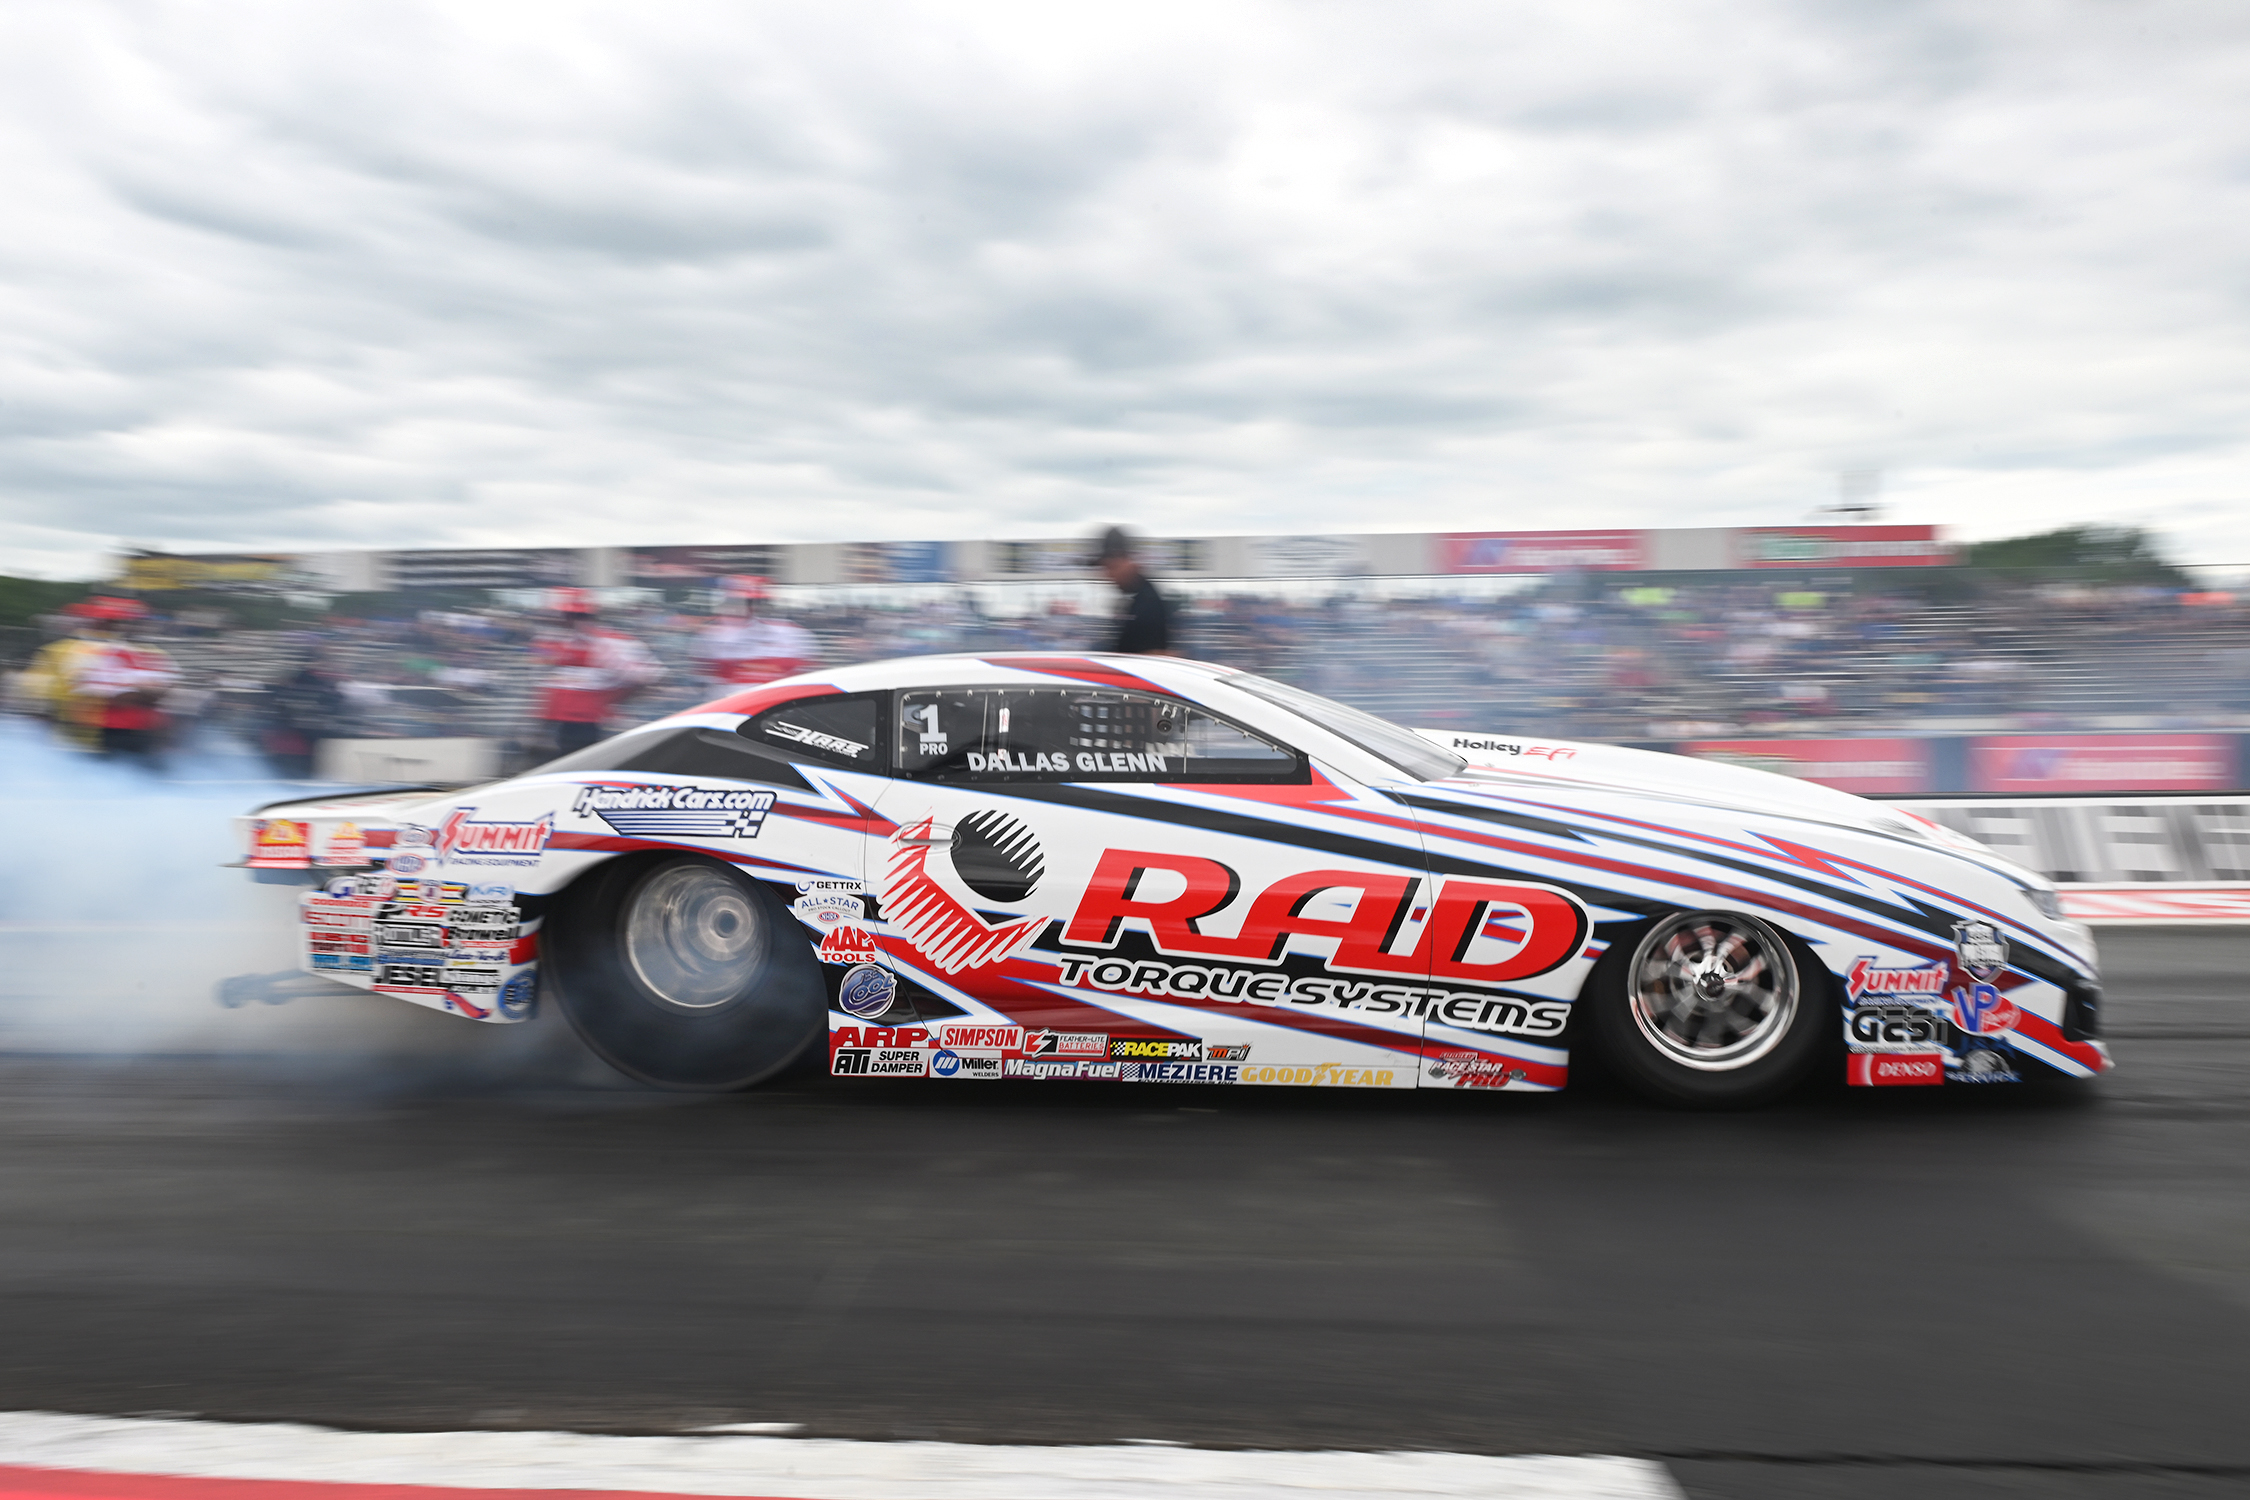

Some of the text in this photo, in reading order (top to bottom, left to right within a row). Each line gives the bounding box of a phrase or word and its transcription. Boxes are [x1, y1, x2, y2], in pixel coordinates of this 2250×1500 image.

[920, 704, 947, 743] 1
[919, 743, 948, 755] PRO
[1453, 738, 1521, 755] Holley
[967, 752, 1167, 772] DALLAS GLENN
[816, 881, 862, 890] GETTRX
[1063, 847, 1588, 982] RAD
[821, 926, 876, 952] MAC
[822, 953, 876, 962] TOOLS
[1059, 958, 1570, 1034] TORQUE SYSTEMS
[1954, 984, 1999, 1032] VP
[830, 1027, 929, 1047] ARP
[944, 1028, 1018, 1047] SIMPSON
[1058, 1042, 1104, 1050] BATTERIES
[878, 1051, 919, 1061] SUPER
[1124, 1042, 1201, 1057] RACEPAK
[834, 1049, 871, 1074] ATI
[871, 1063, 923, 1074] DAMPER
[961, 1058, 998, 1070] Miller
[1003, 1059, 1122, 1080] MagnaFuel
[1876, 1061, 1938, 1077] DENSO
[1138, 1064, 1239, 1082] MEZIERE
